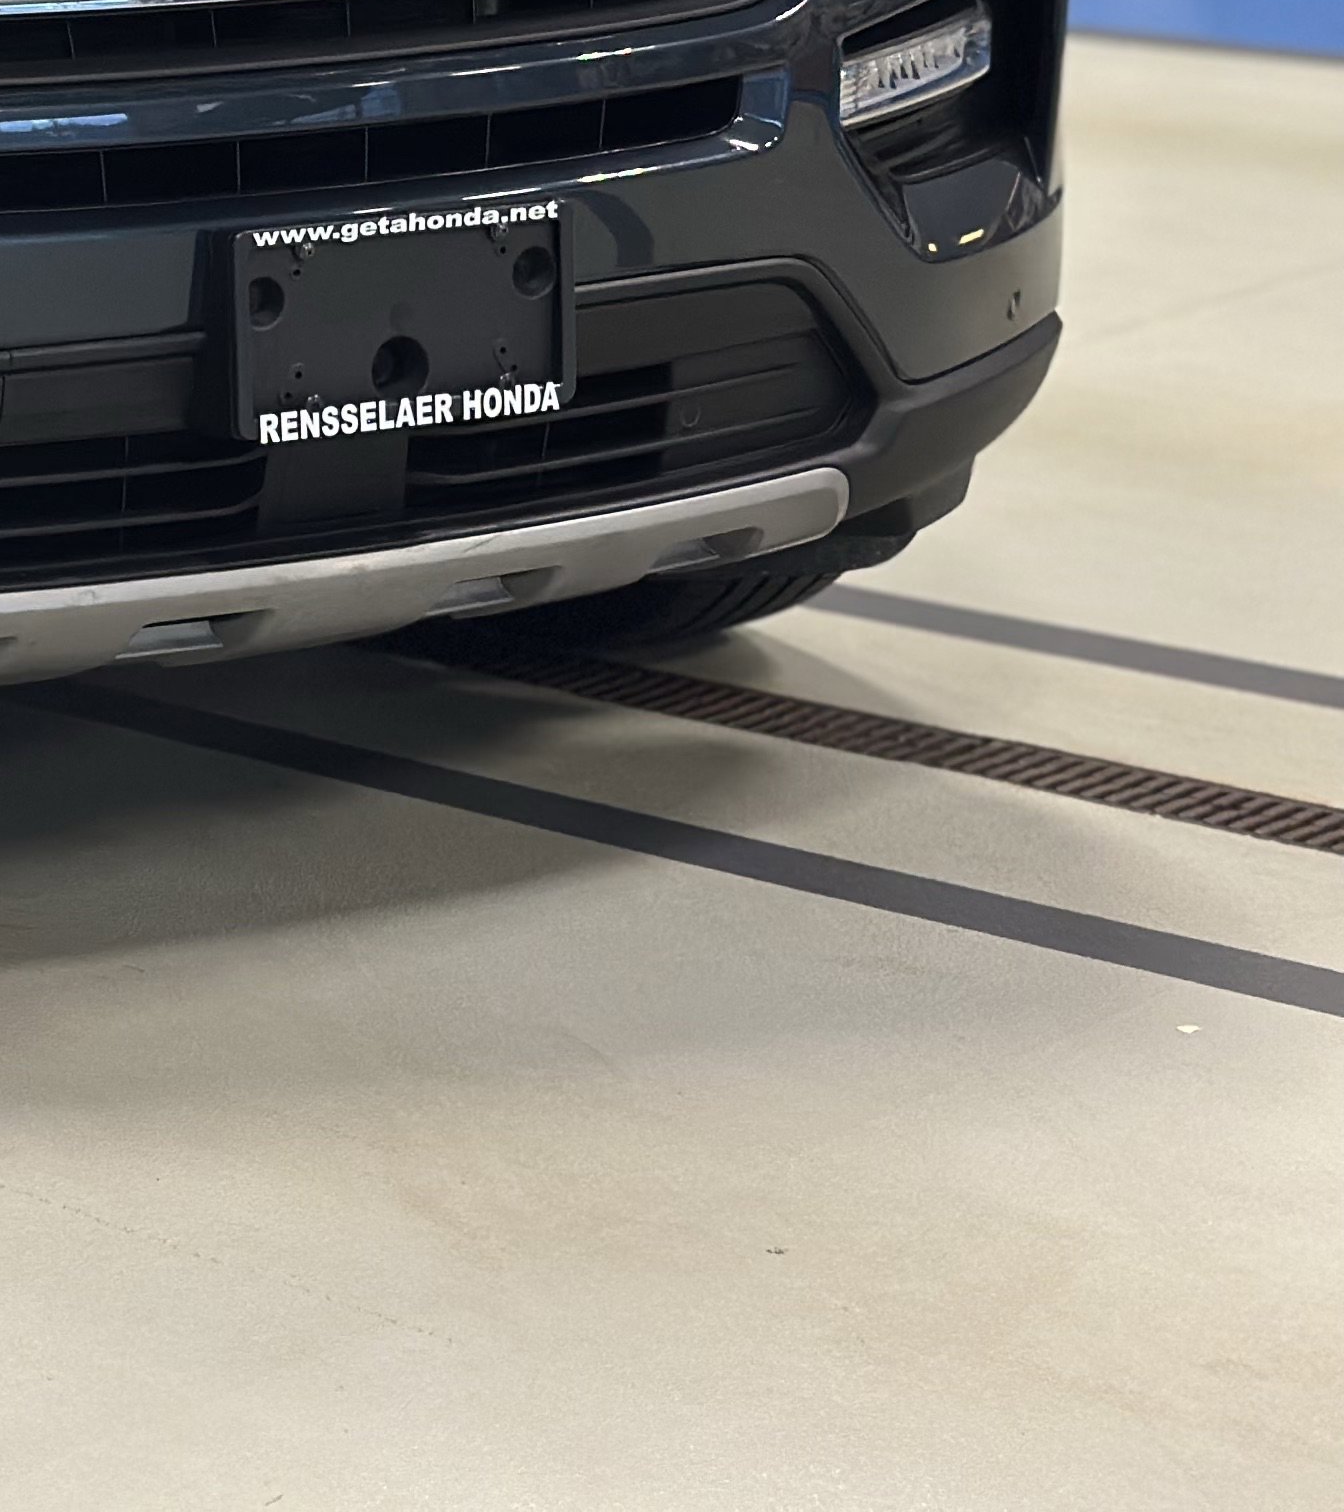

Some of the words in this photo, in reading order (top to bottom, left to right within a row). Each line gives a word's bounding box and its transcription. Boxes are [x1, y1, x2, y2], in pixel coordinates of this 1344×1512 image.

[252, 199, 560, 248] www.getahonda.net
[258, 392, 454, 446] RENSSELAER
[461, 380, 561, 422] HONDA
